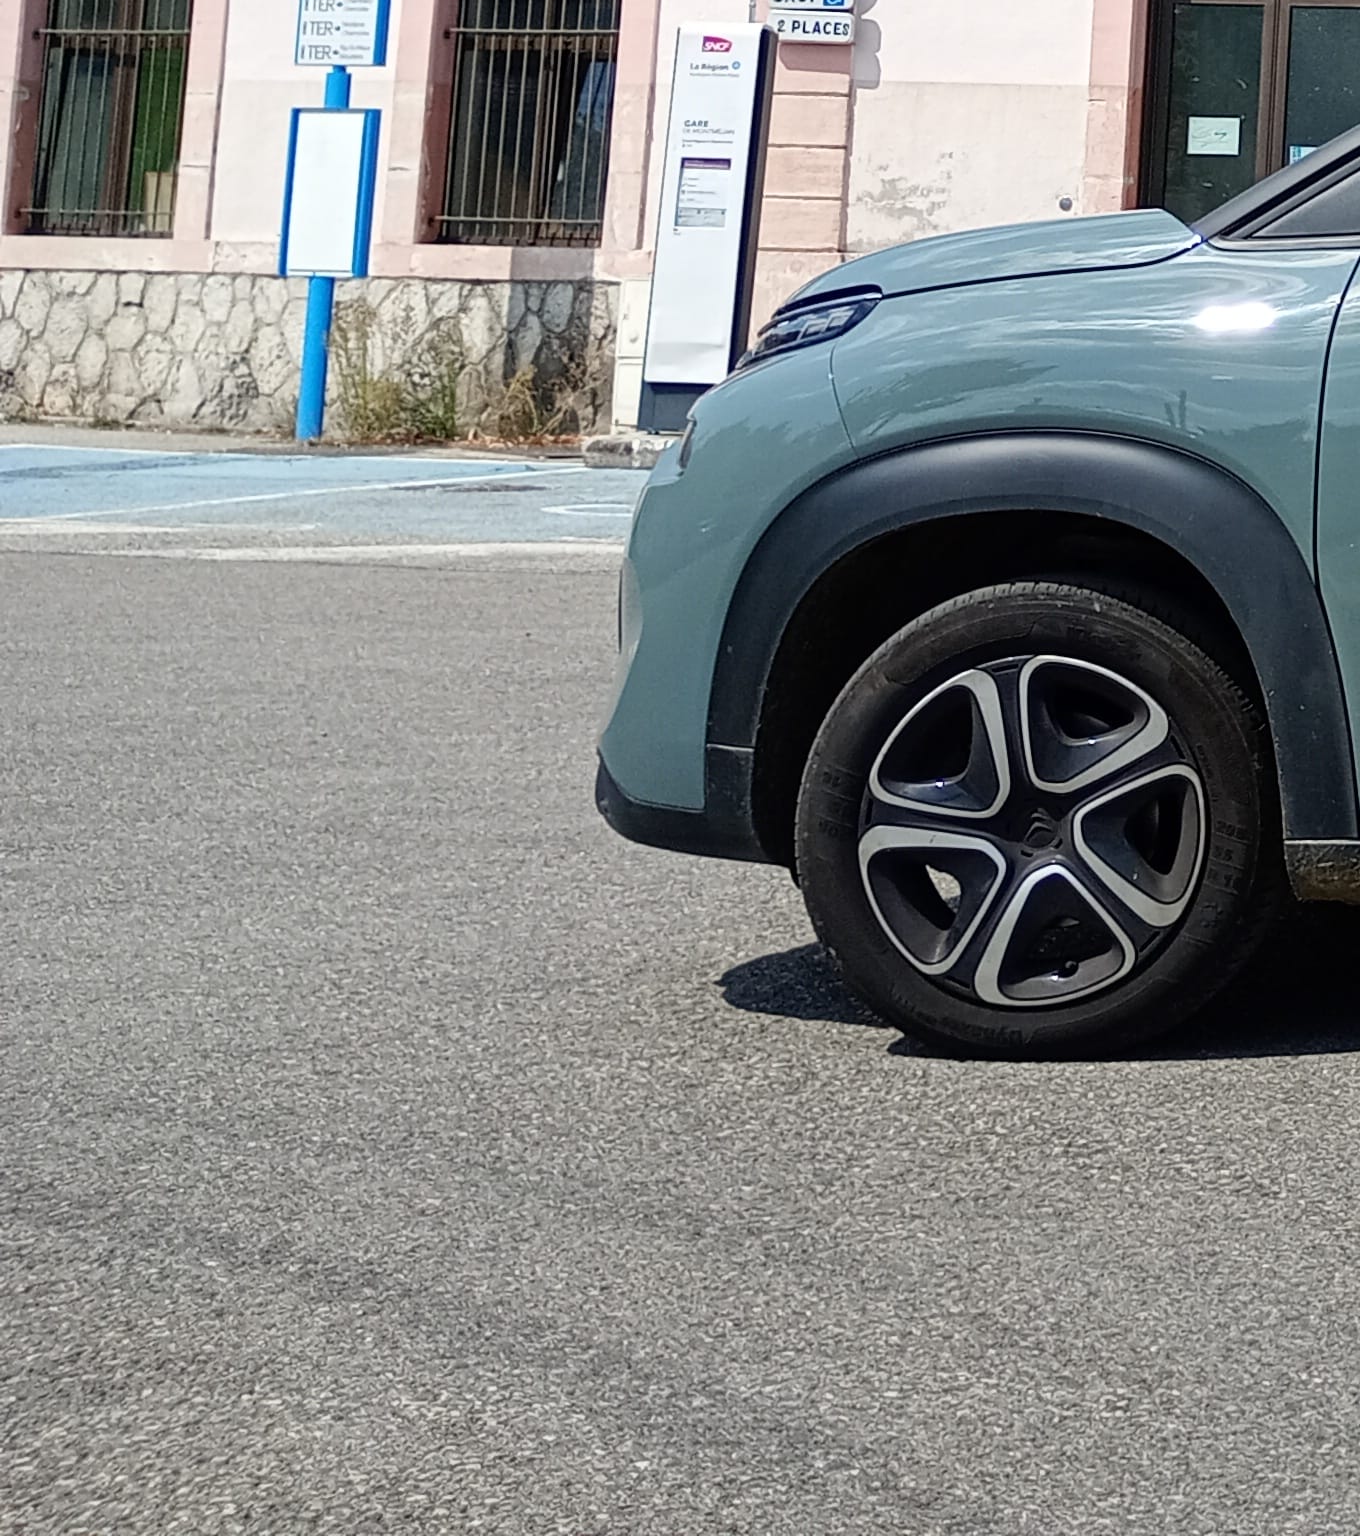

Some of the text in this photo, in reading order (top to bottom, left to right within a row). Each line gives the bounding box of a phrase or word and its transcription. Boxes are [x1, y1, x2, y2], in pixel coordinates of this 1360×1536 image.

[309, 20, 334, 36] TER
[777, 19, 850, 36] 2 PLACES
[308, 44, 332, 60] TER
[703, 42, 731, 51] SNCF
